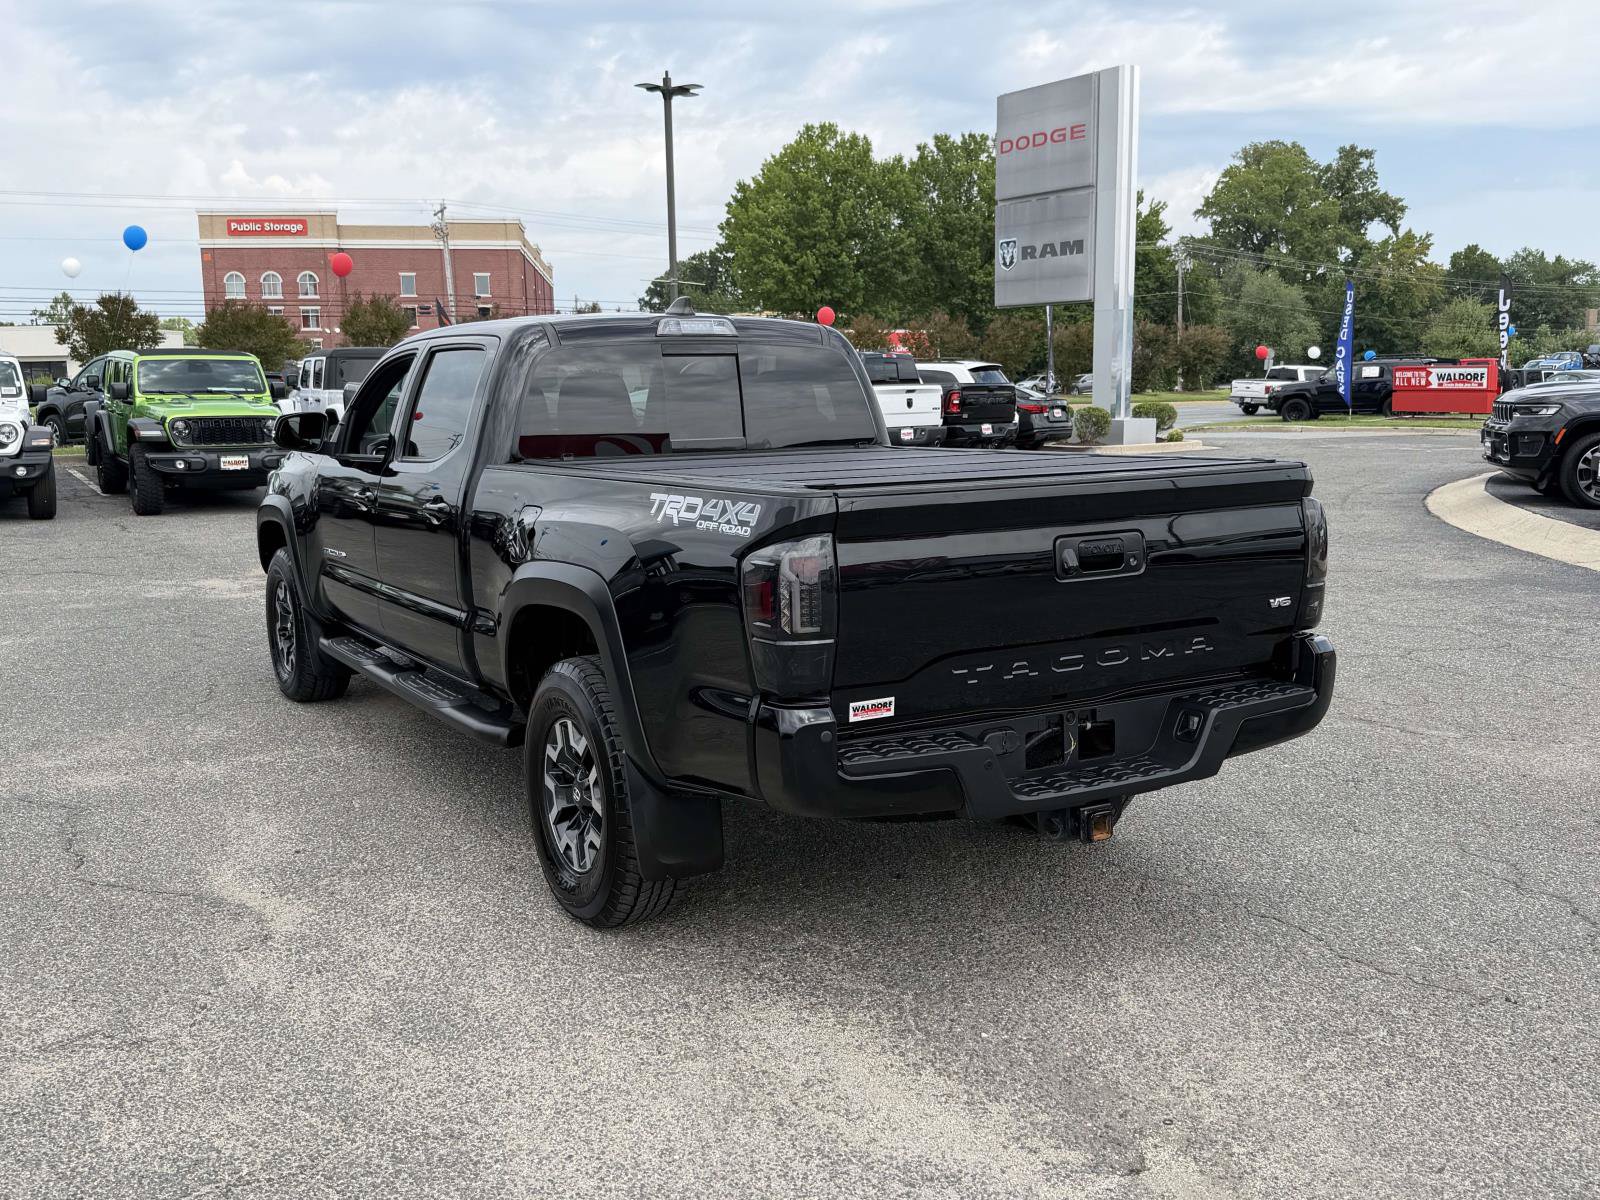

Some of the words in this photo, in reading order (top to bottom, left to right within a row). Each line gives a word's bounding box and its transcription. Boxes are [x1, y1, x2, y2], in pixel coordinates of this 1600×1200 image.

[1000, 123, 1086, 154] DODGE
[230, 222, 261, 231] Public
[264, 222, 304, 233] Storage
[1021, 239, 1084, 261] RAM
[1395, 378, 1408, 386] ALL
[1410, 378, 1427, 386] NEW
[1436, 373, 1485, 382] WALDORF
[696, 520, 719, 531] OFF
[718, 523, 751, 537] ROAD
[1087, 543, 1123, 554] TOYOTA
[952, 637, 1214, 684] TACOMA
[852, 701, 893, 713] WALDORF
